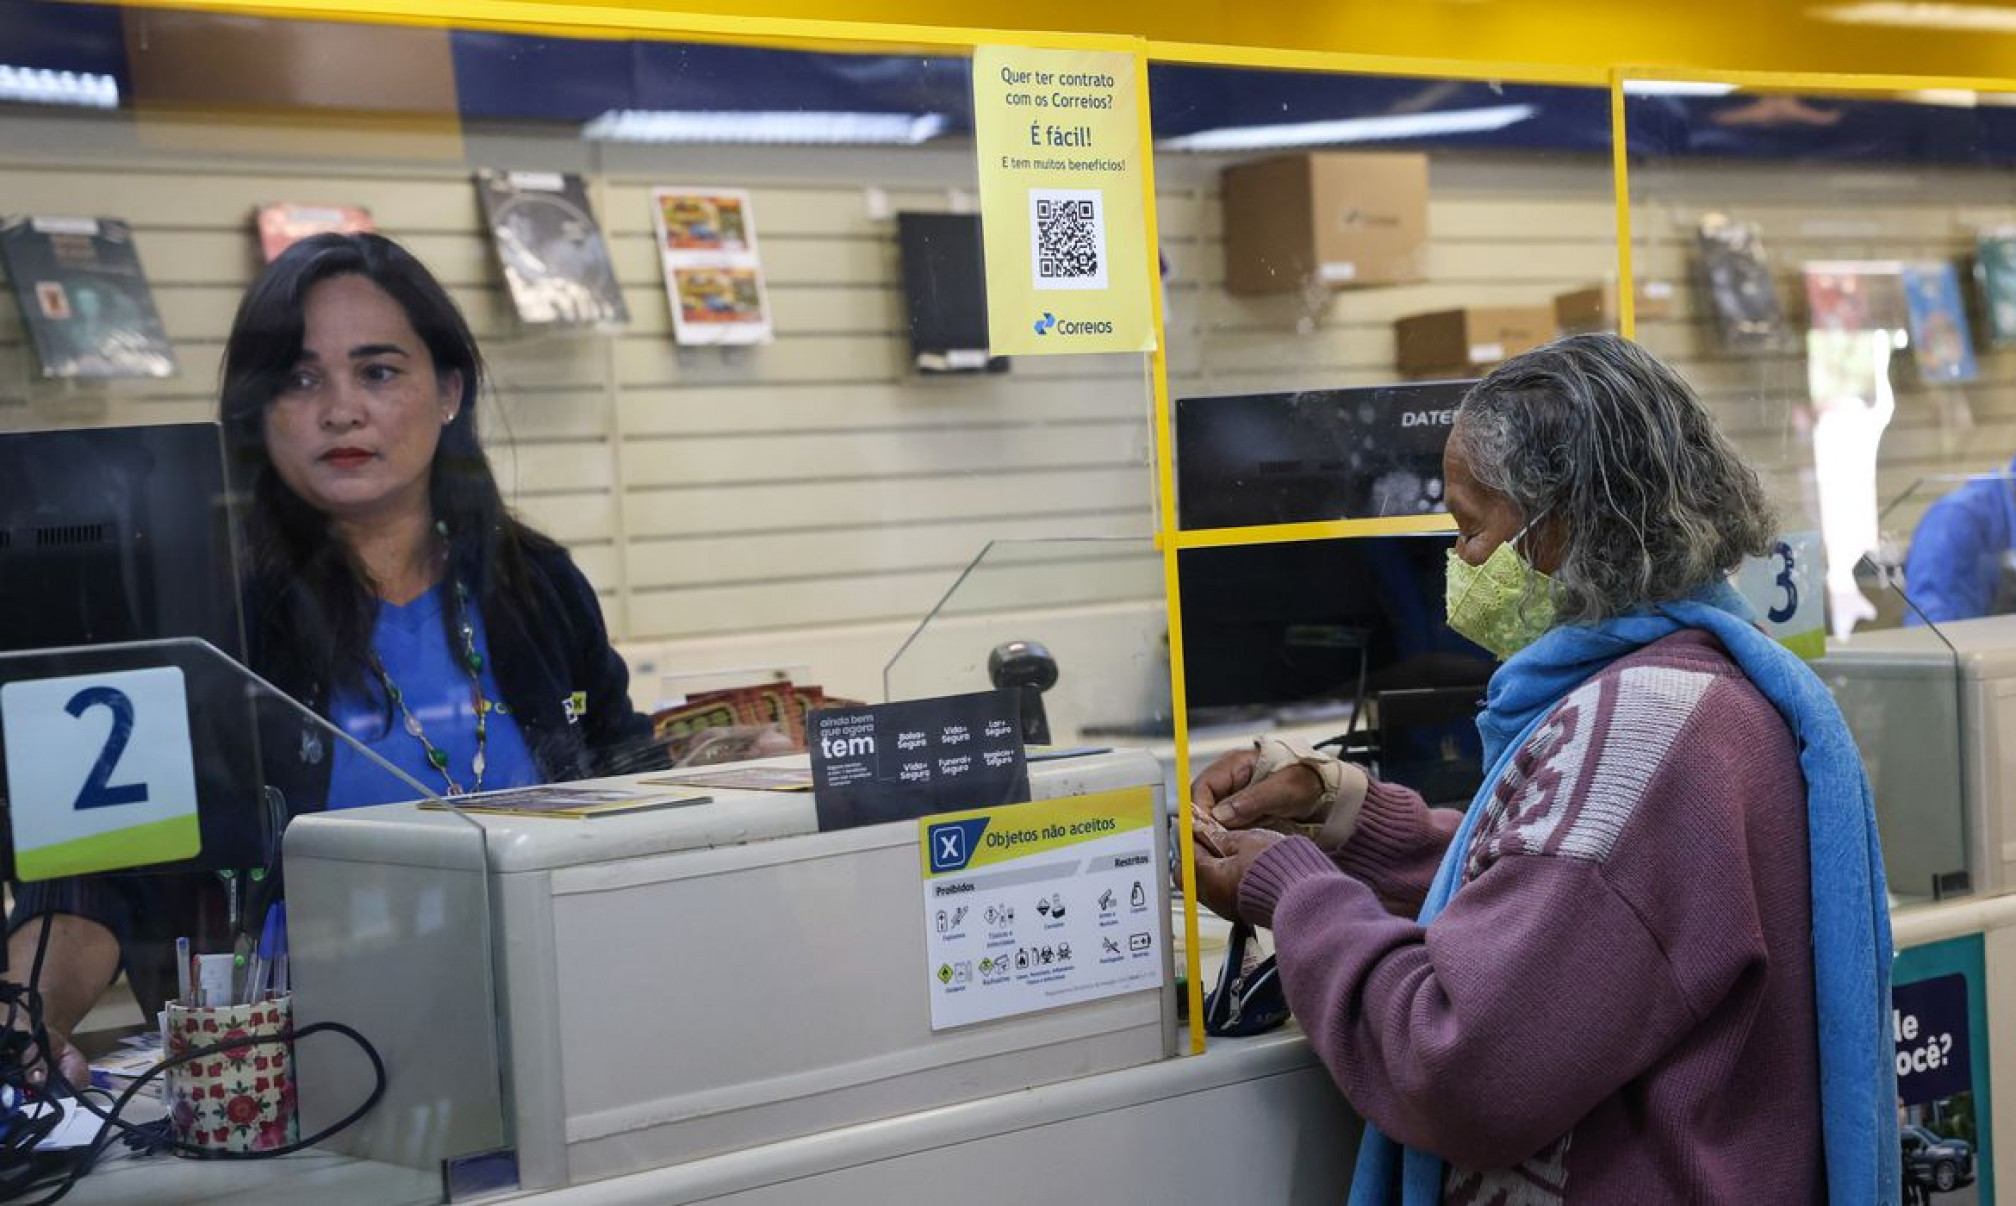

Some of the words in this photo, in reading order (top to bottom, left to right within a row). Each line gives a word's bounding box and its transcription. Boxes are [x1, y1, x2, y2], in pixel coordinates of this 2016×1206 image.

[1001, 67, 1031, 85] Quer
[1035, 71, 1054, 85] ter
[1059, 73, 1114, 87] contrato
[1006, 93, 1031, 106] com
[1035, 95, 1048, 107] os
[1052, 93, 1113, 109] Correios?
[1031, 121, 1041, 145] É
[1046, 125, 1092, 147] fácil!
[1002, 157, 1009, 168] E
[1011, 158, 1031, 168] tem
[1034, 159, 1066, 170] muitos
[1058, 320, 1113, 335] Correios
[1768, 541, 1798, 623] 3
[64, 686, 149, 811] 2
[821, 736, 875, 759] tem
[986, 829, 1038, 849] Objetos
[1042, 824, 1066, 840] não
[1070, 818, 1116, 835] aceitos
[936, 882, 975, 897] Proibidos
[1896, 1032, 1953, 1076] ocê?
